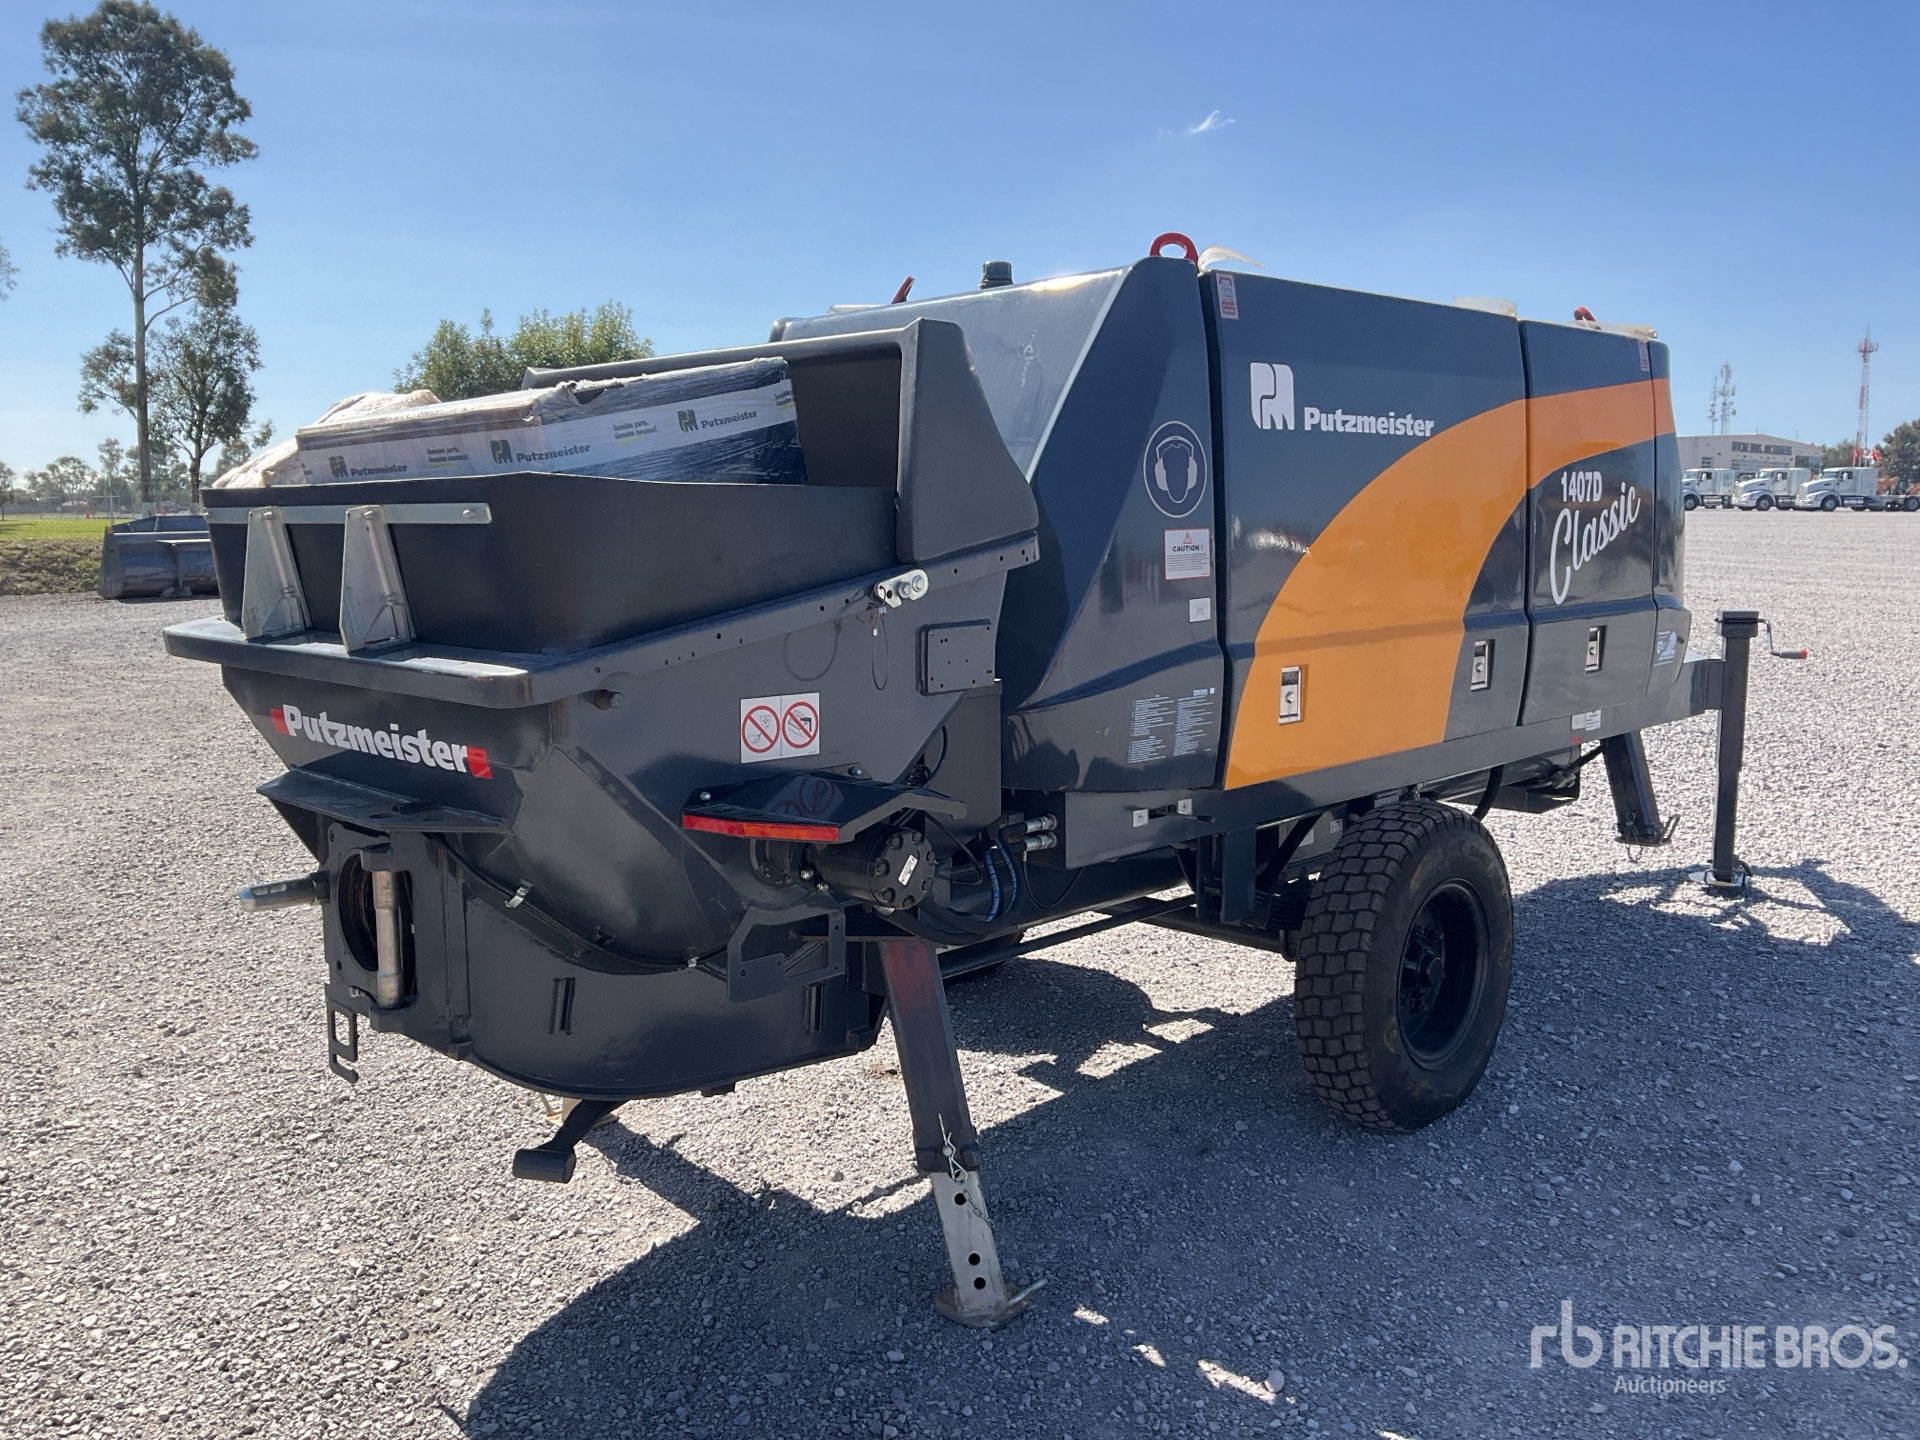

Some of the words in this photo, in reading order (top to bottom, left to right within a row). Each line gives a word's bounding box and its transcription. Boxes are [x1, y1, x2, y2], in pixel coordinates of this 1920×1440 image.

[701, 410, 758, 429] Putzmeister
[1304, 406, 1435, 437] Putzmeister
[516, 444, 591, 462] Putzmeister
[350, 464, 408, 477] Putzmeister
[1560, 471, 1603, 503] 1407D
[1172, 544, 1200, 552] CAUTION
[1549, 482, 1642, 605] Classic
[282, 704, 468, 772] Putzmeister
